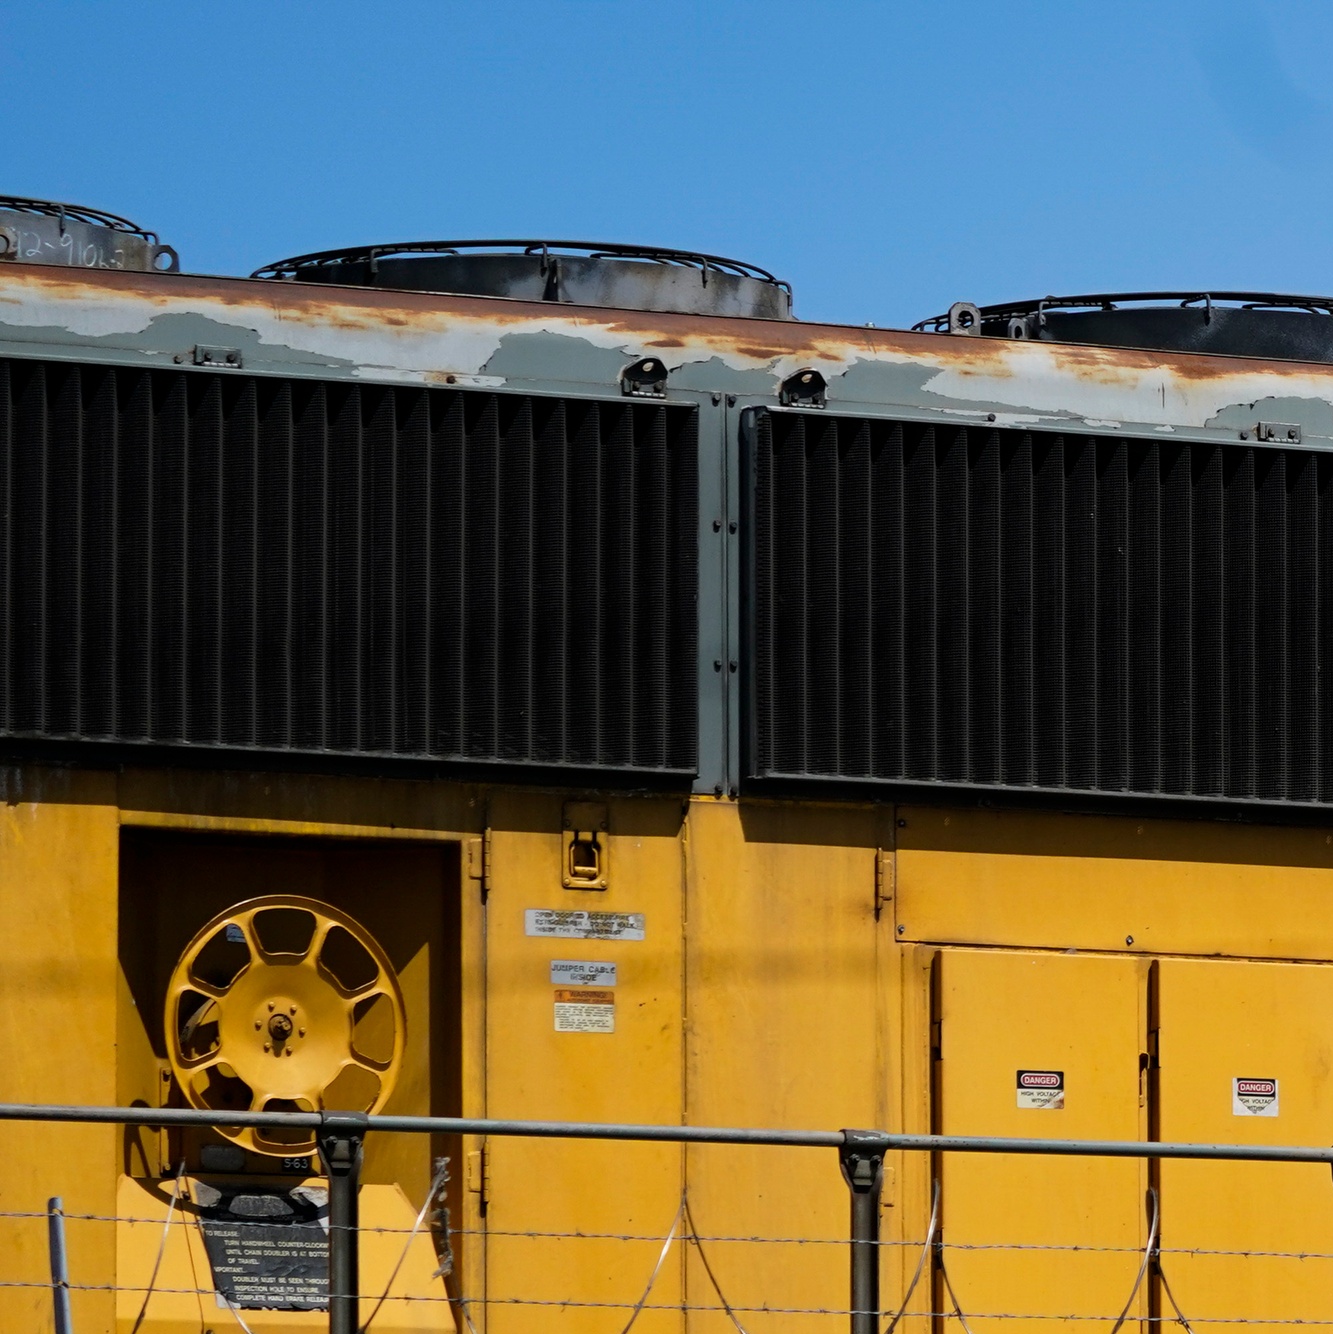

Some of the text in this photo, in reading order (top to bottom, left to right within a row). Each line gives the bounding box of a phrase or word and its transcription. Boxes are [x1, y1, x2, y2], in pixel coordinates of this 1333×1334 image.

[551, 964, 585, 973] JUMPER
[1024, 1076, 1057, 1084] DANGER
[1240, 1083, 1272, 1091] DANGER
[284, 1159, 308, 1169] S-63
[236, 1294, 266, 1302] COMPLETE
